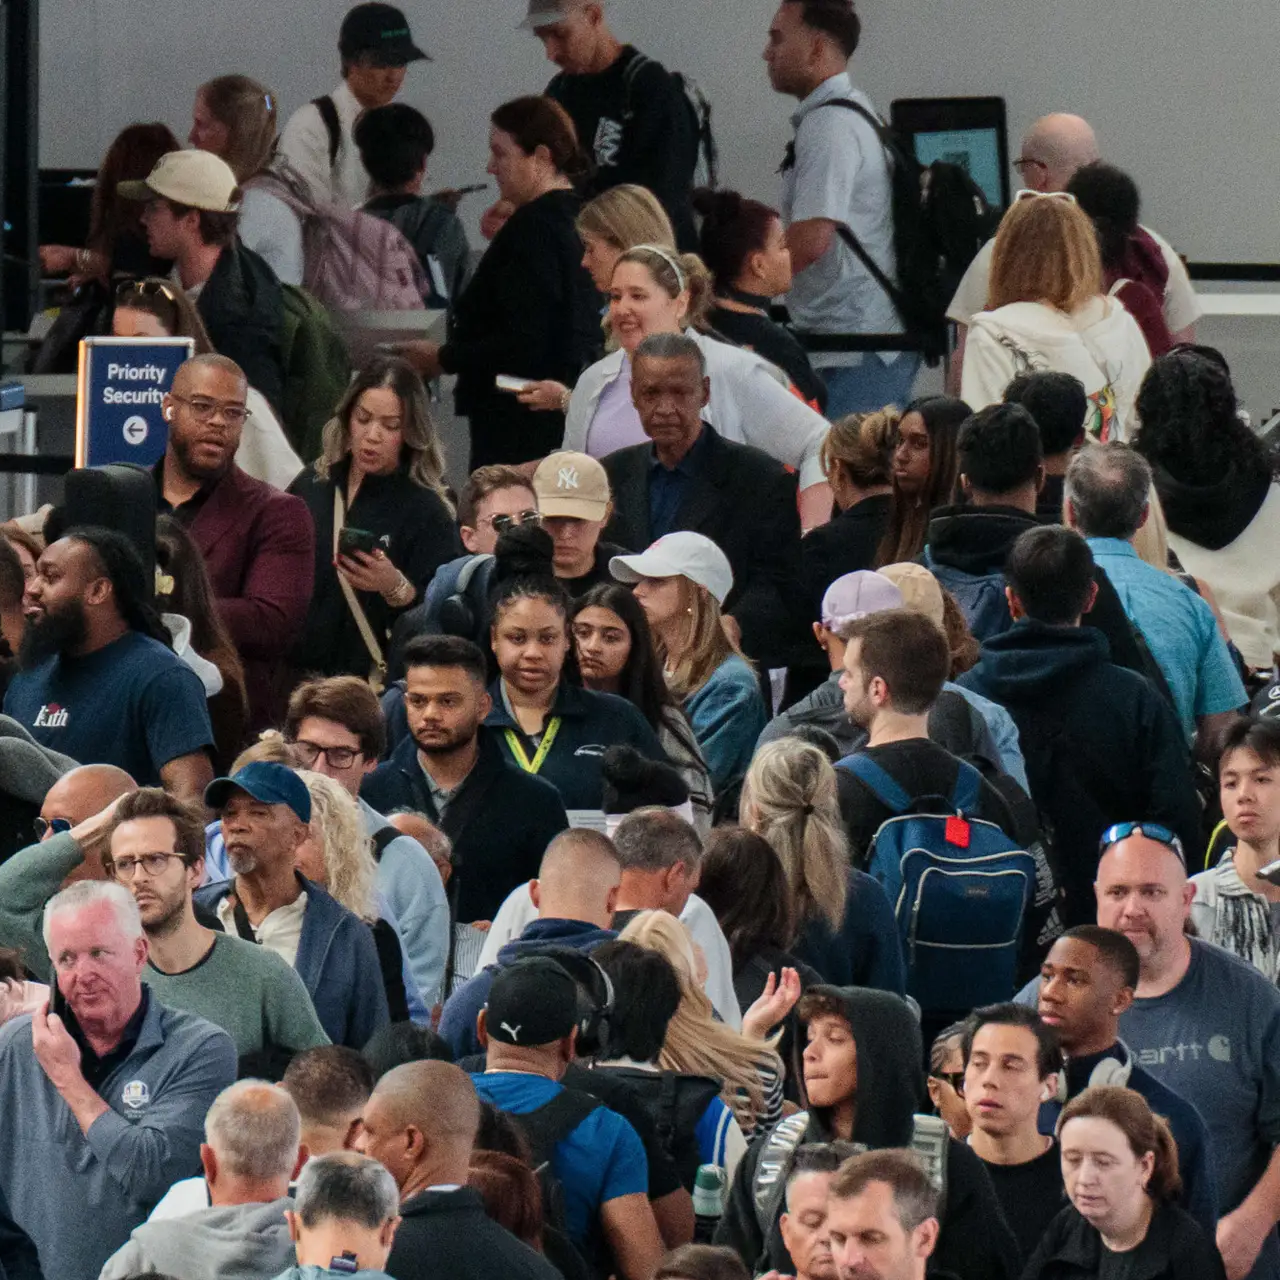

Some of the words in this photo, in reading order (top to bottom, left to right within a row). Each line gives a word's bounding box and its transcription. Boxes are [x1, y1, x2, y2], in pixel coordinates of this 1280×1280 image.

[107, 363, 167, 385] Priority
[103, 386, 170, 409] Security
[557, 465, 579, 490] NY
